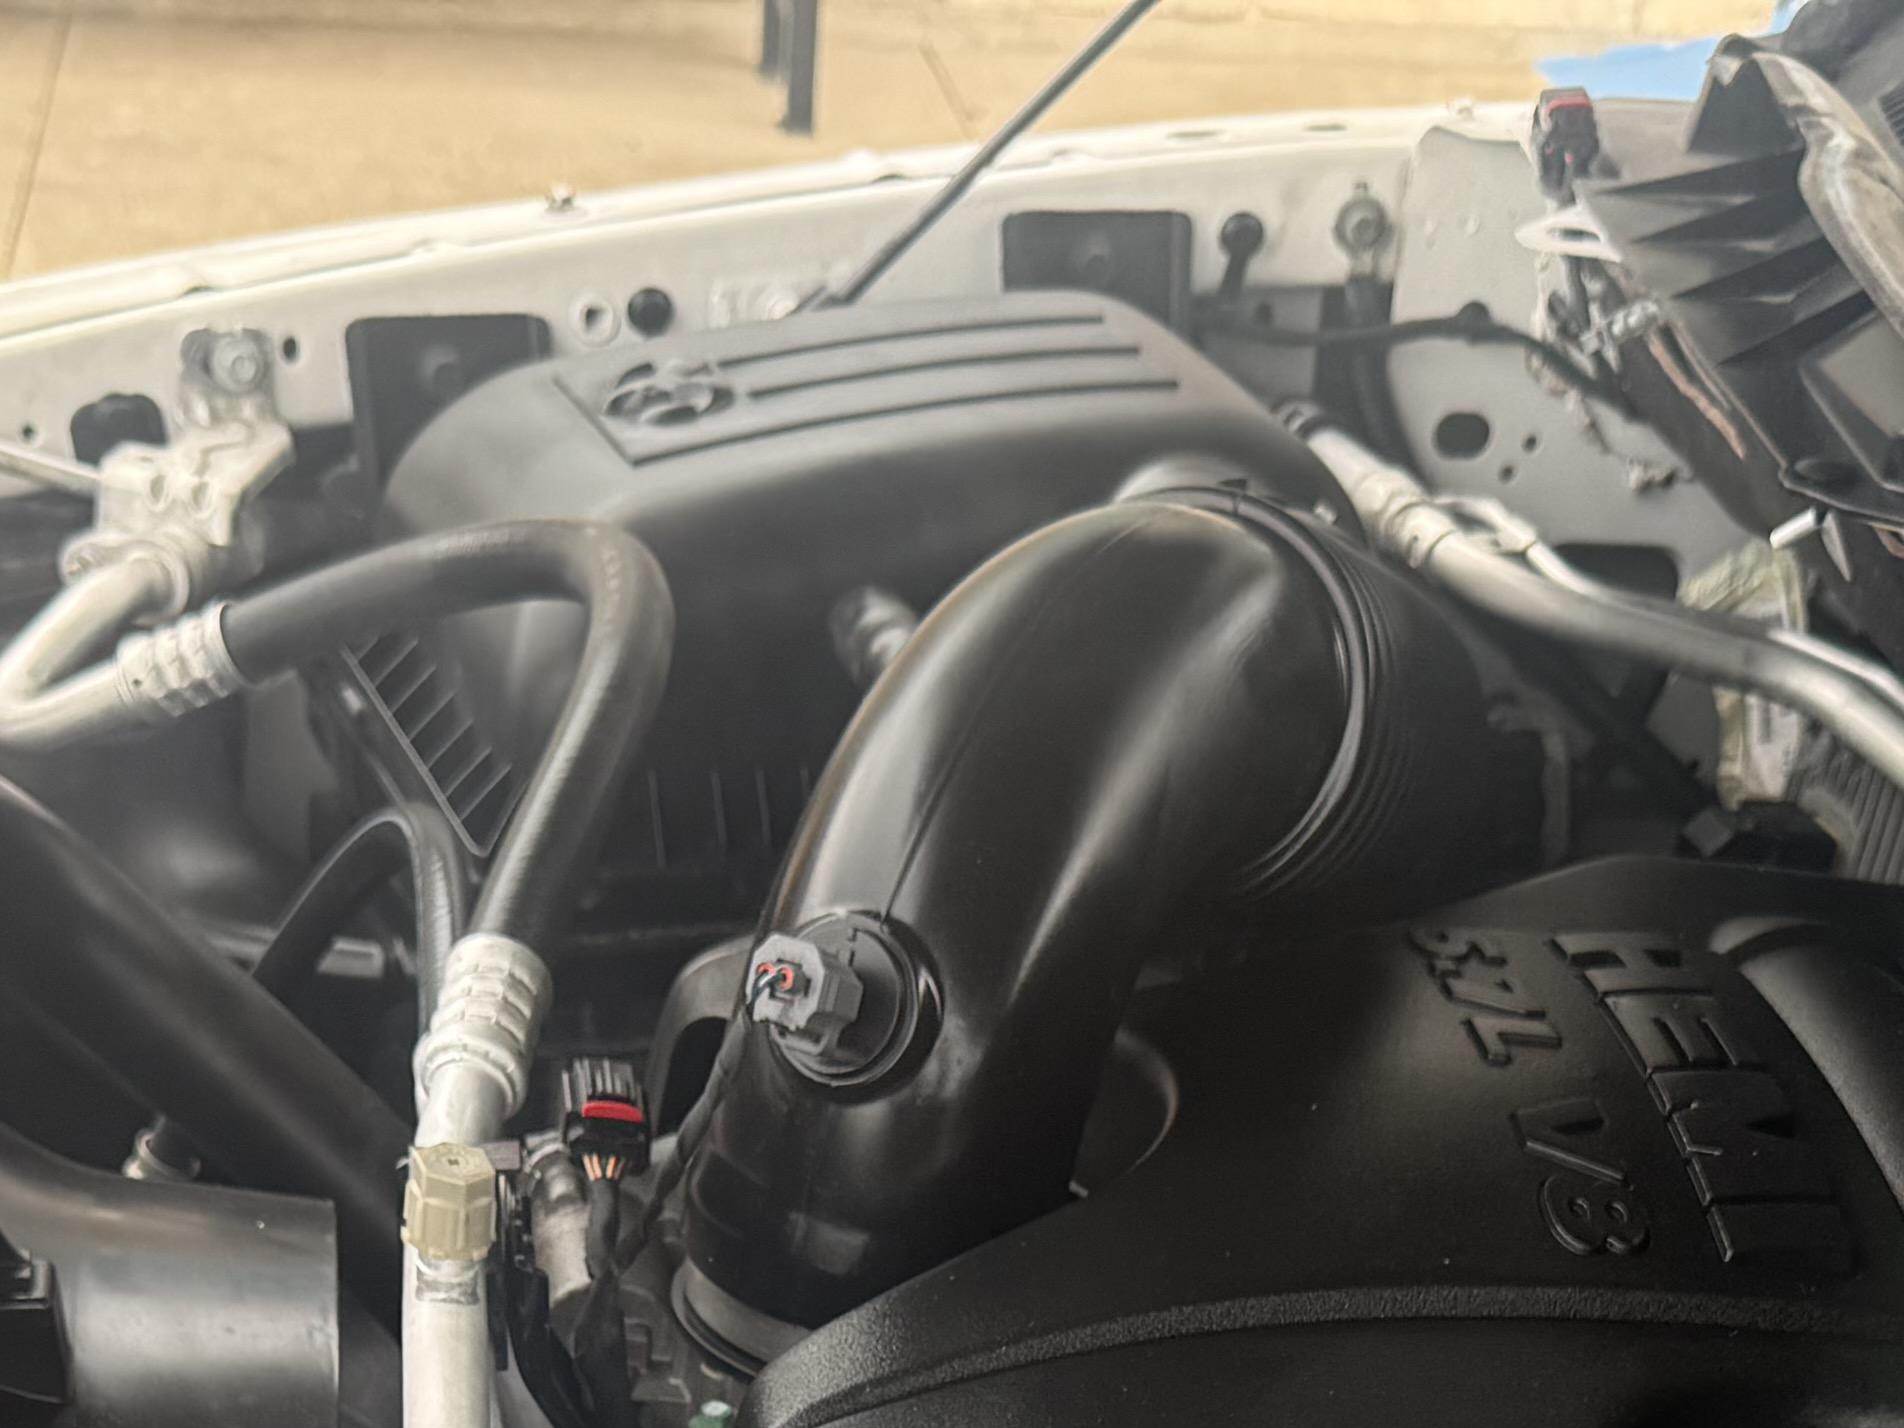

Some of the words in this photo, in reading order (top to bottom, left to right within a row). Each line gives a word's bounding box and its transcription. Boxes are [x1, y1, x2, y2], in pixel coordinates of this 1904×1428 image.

[1408, 926, 1563, 1068] 5.7L
[1508, 1098, 1652, 1260] V8
[1546, 928, 1848, 1263] HEMI
